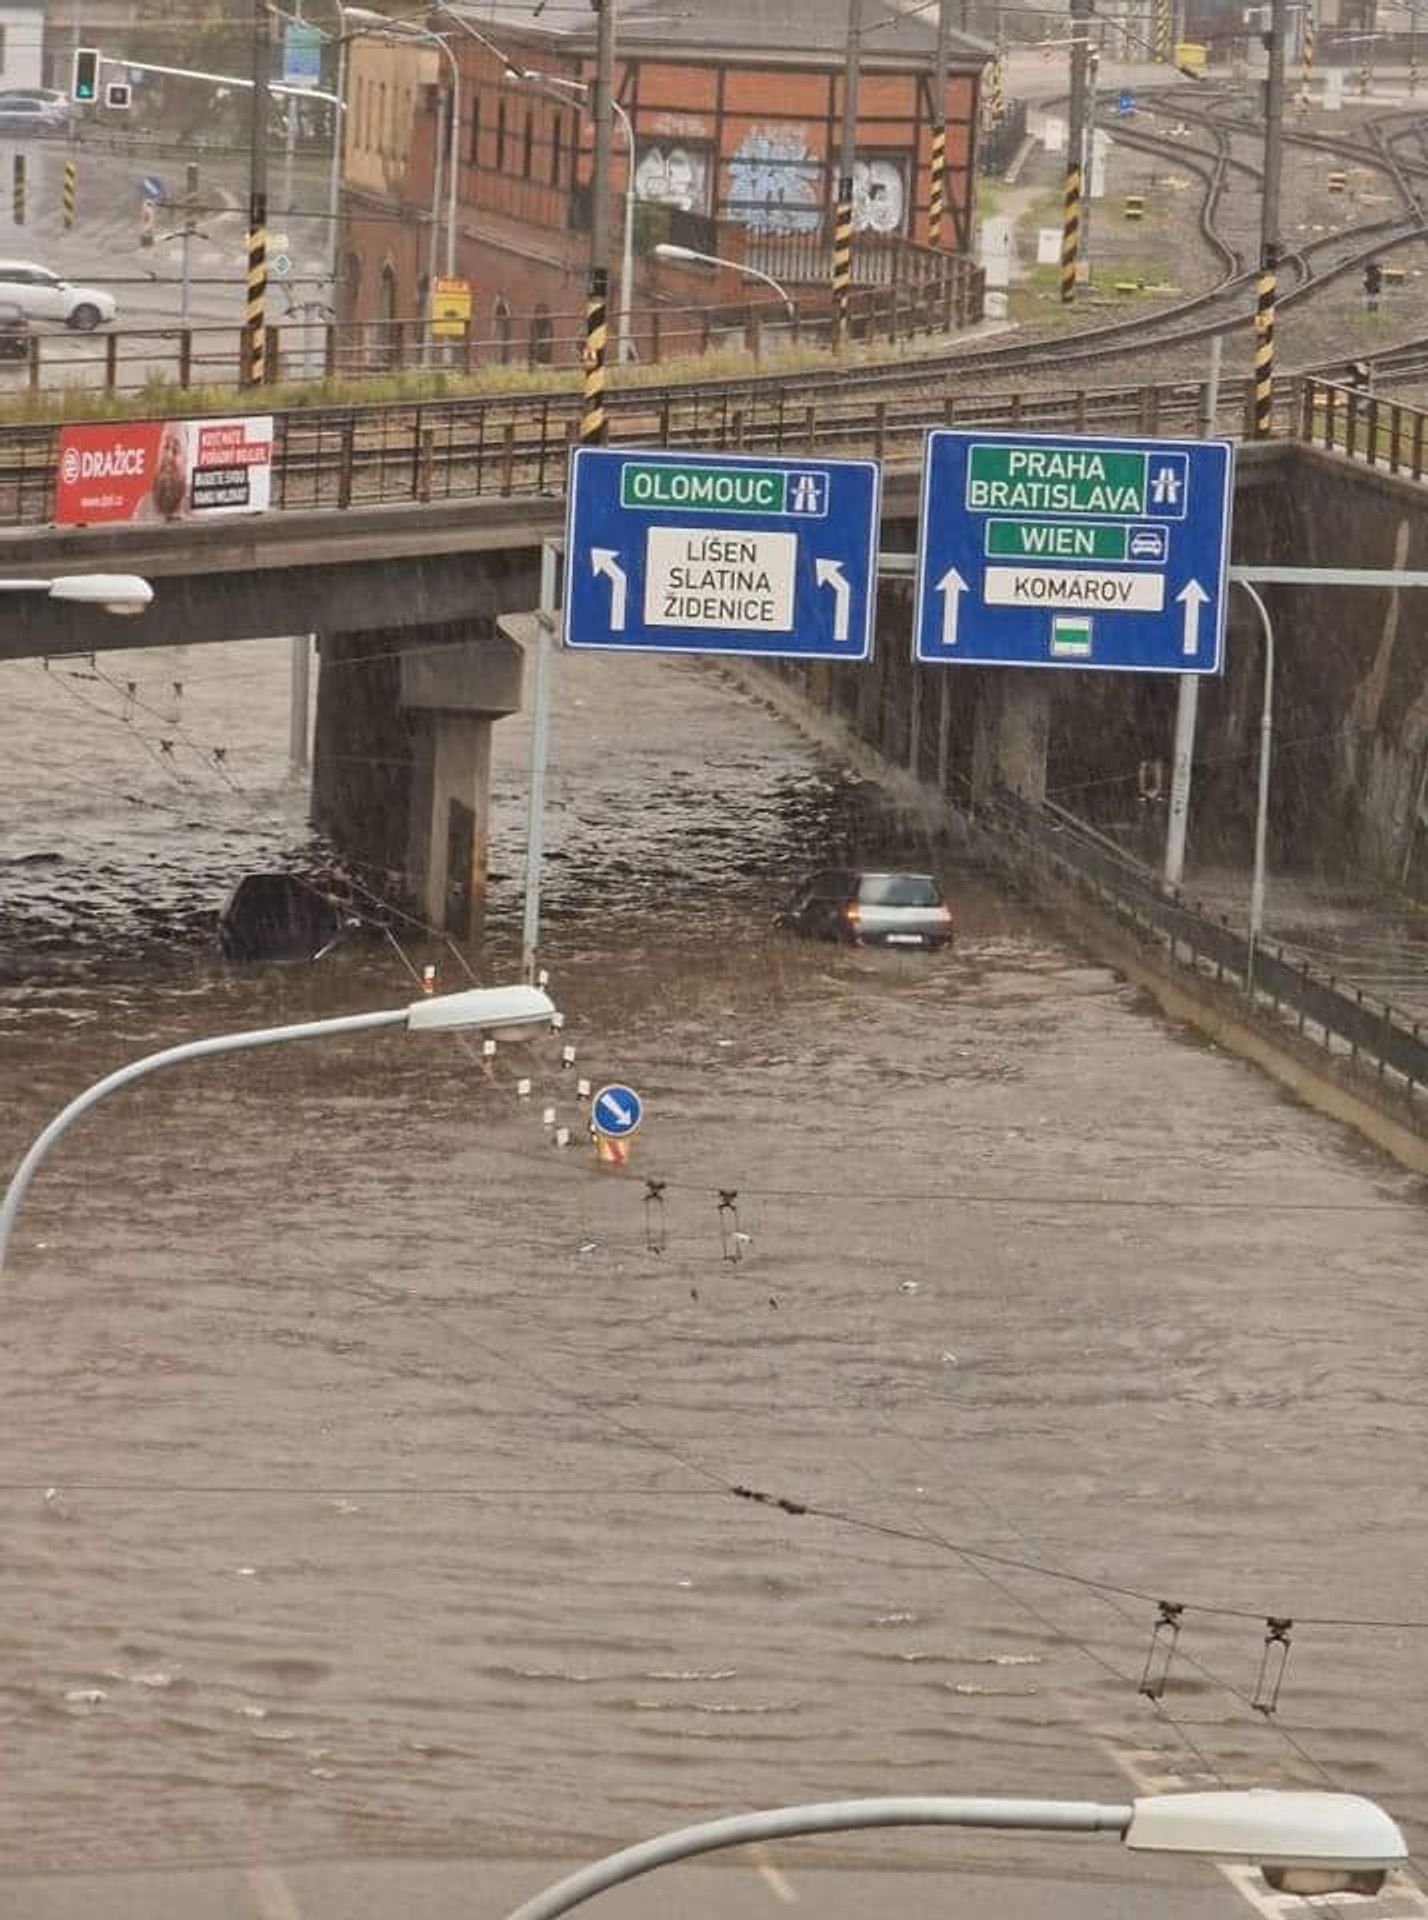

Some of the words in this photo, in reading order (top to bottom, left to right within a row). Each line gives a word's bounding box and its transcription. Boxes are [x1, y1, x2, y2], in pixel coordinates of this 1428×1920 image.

[81, 444, 145, 478] DRAŽICE
[1008, 451, 1105, 481] PRAHA
[633, 473, 774, 504] OLOMOUC
[970, 480, 1141, 512] BRATISLAVA
[687, 536, 757, 563] LÍŠEŇ
[1020, 527, 1096, 554] WIEN
[669, 567, 771, 593] SLATINA
[664, 592, 775, 622] ŽIDENICE
